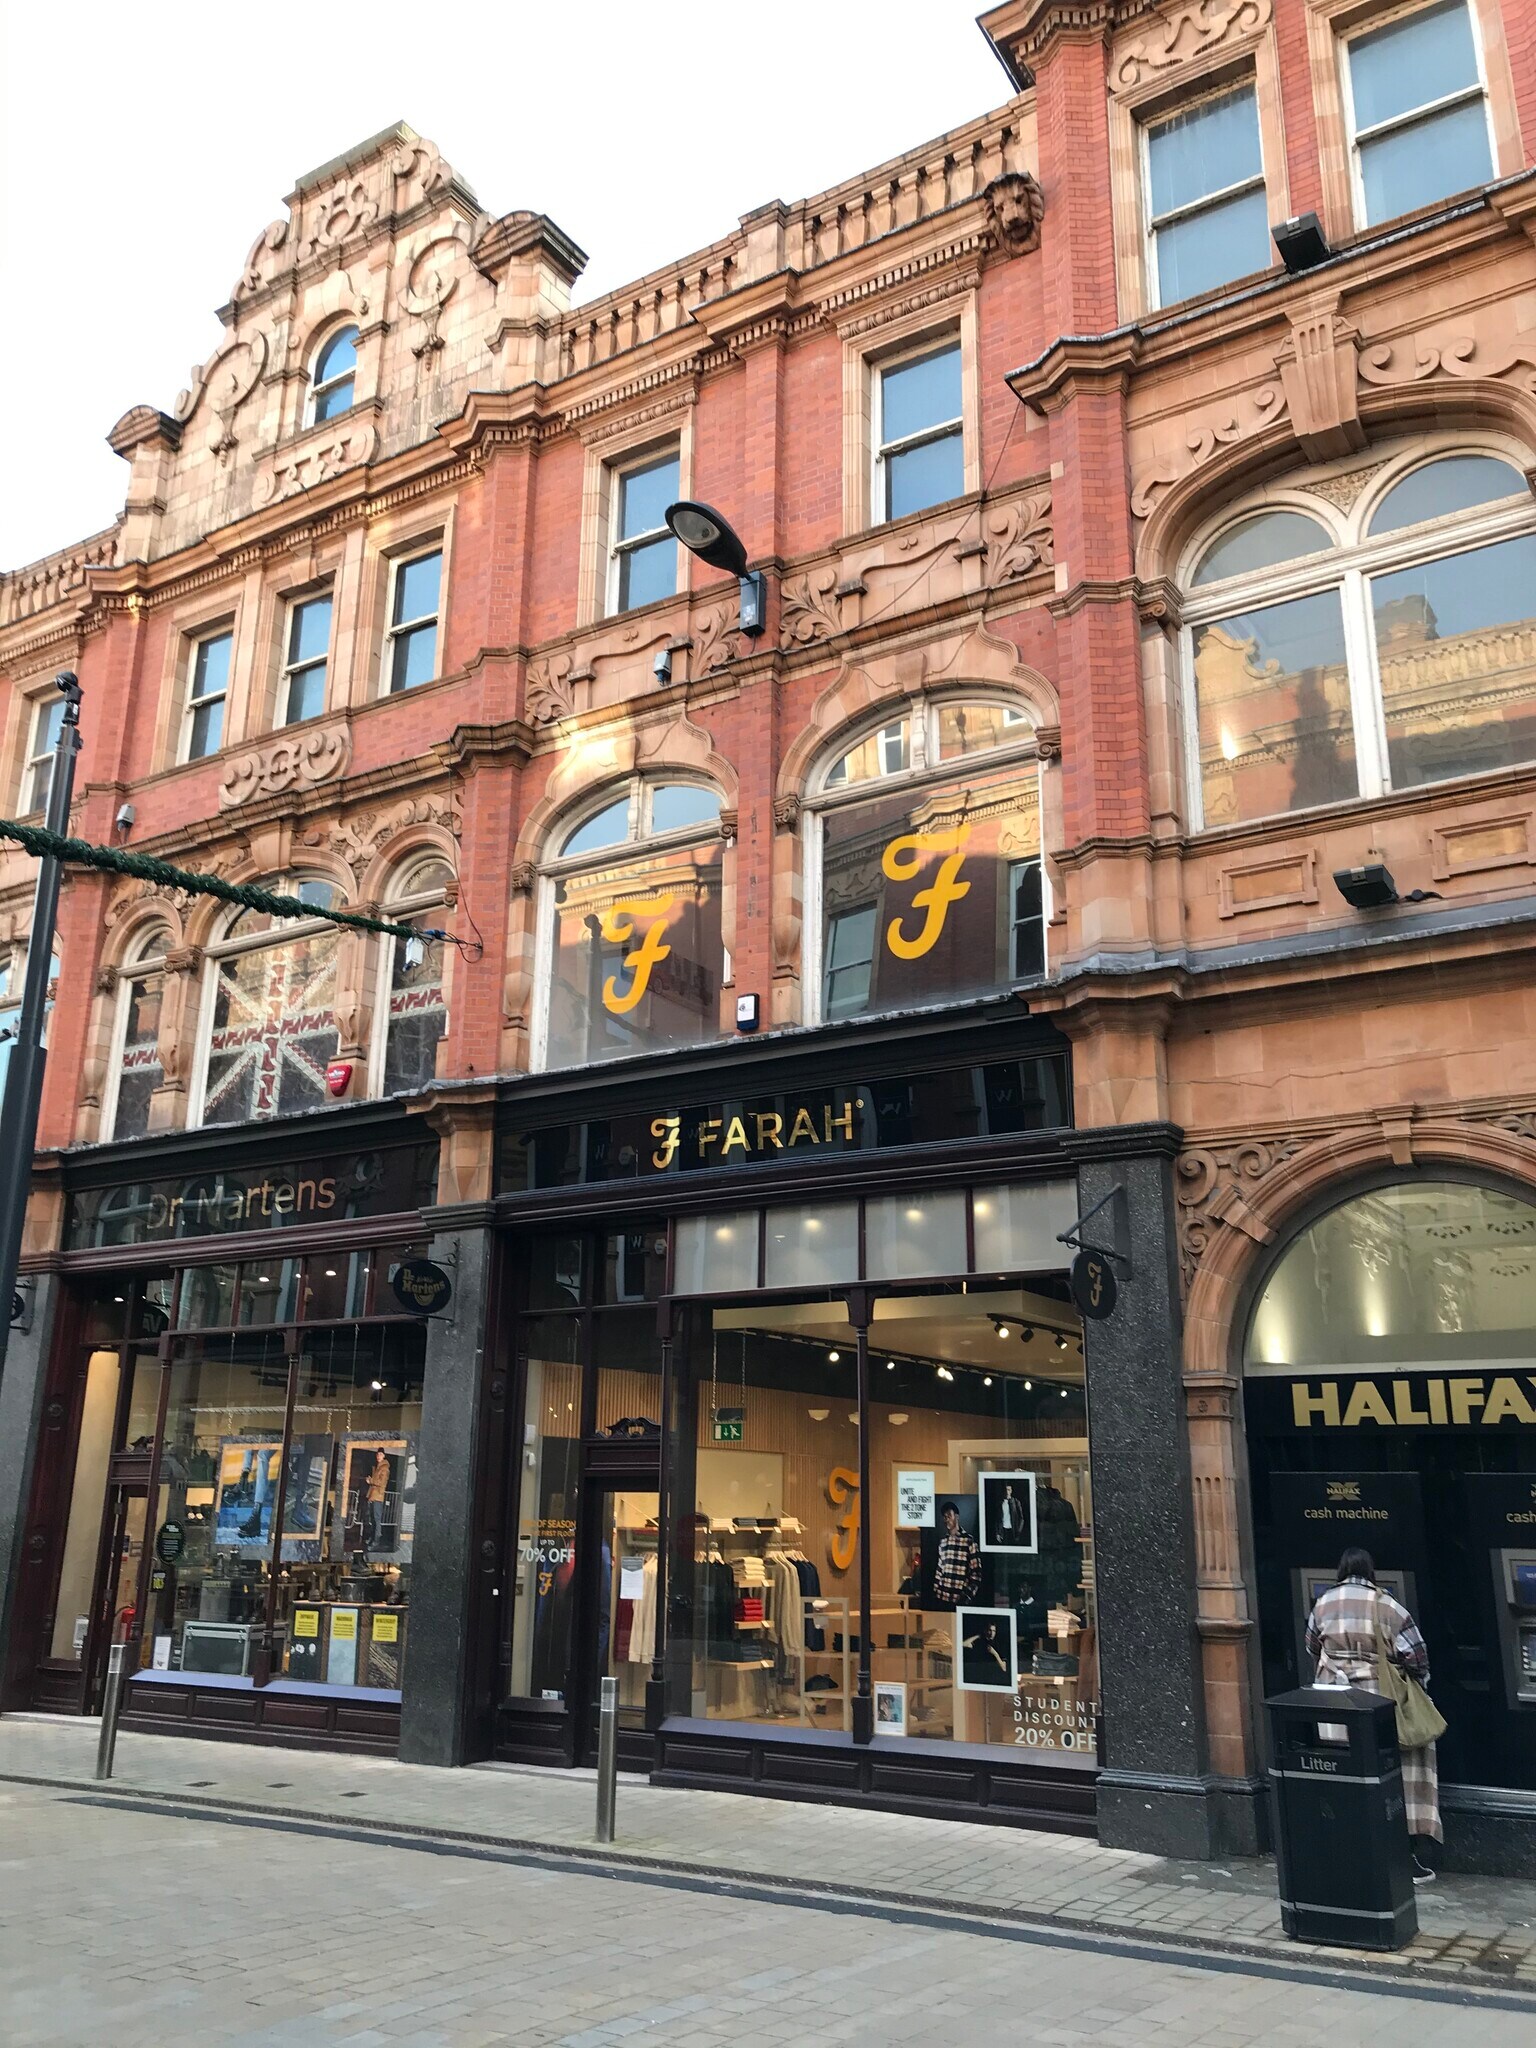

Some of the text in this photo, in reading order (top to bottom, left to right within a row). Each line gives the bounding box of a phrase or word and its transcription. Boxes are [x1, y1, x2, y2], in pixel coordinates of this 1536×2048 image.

[196, 1177, 336, 1224] Martens
[1291, 1376, 1536, 1427] HALIFA
[1304, 1506, 1389, 1519] cash machine
[520, 1547, 575, 1563] 70% OFF
[1013, 1695, 1098, 1714] STUDENT
[1014, 1726, 1098, 1752] 20% OFF
[1300, 1756, 1338, 1772] Litter
